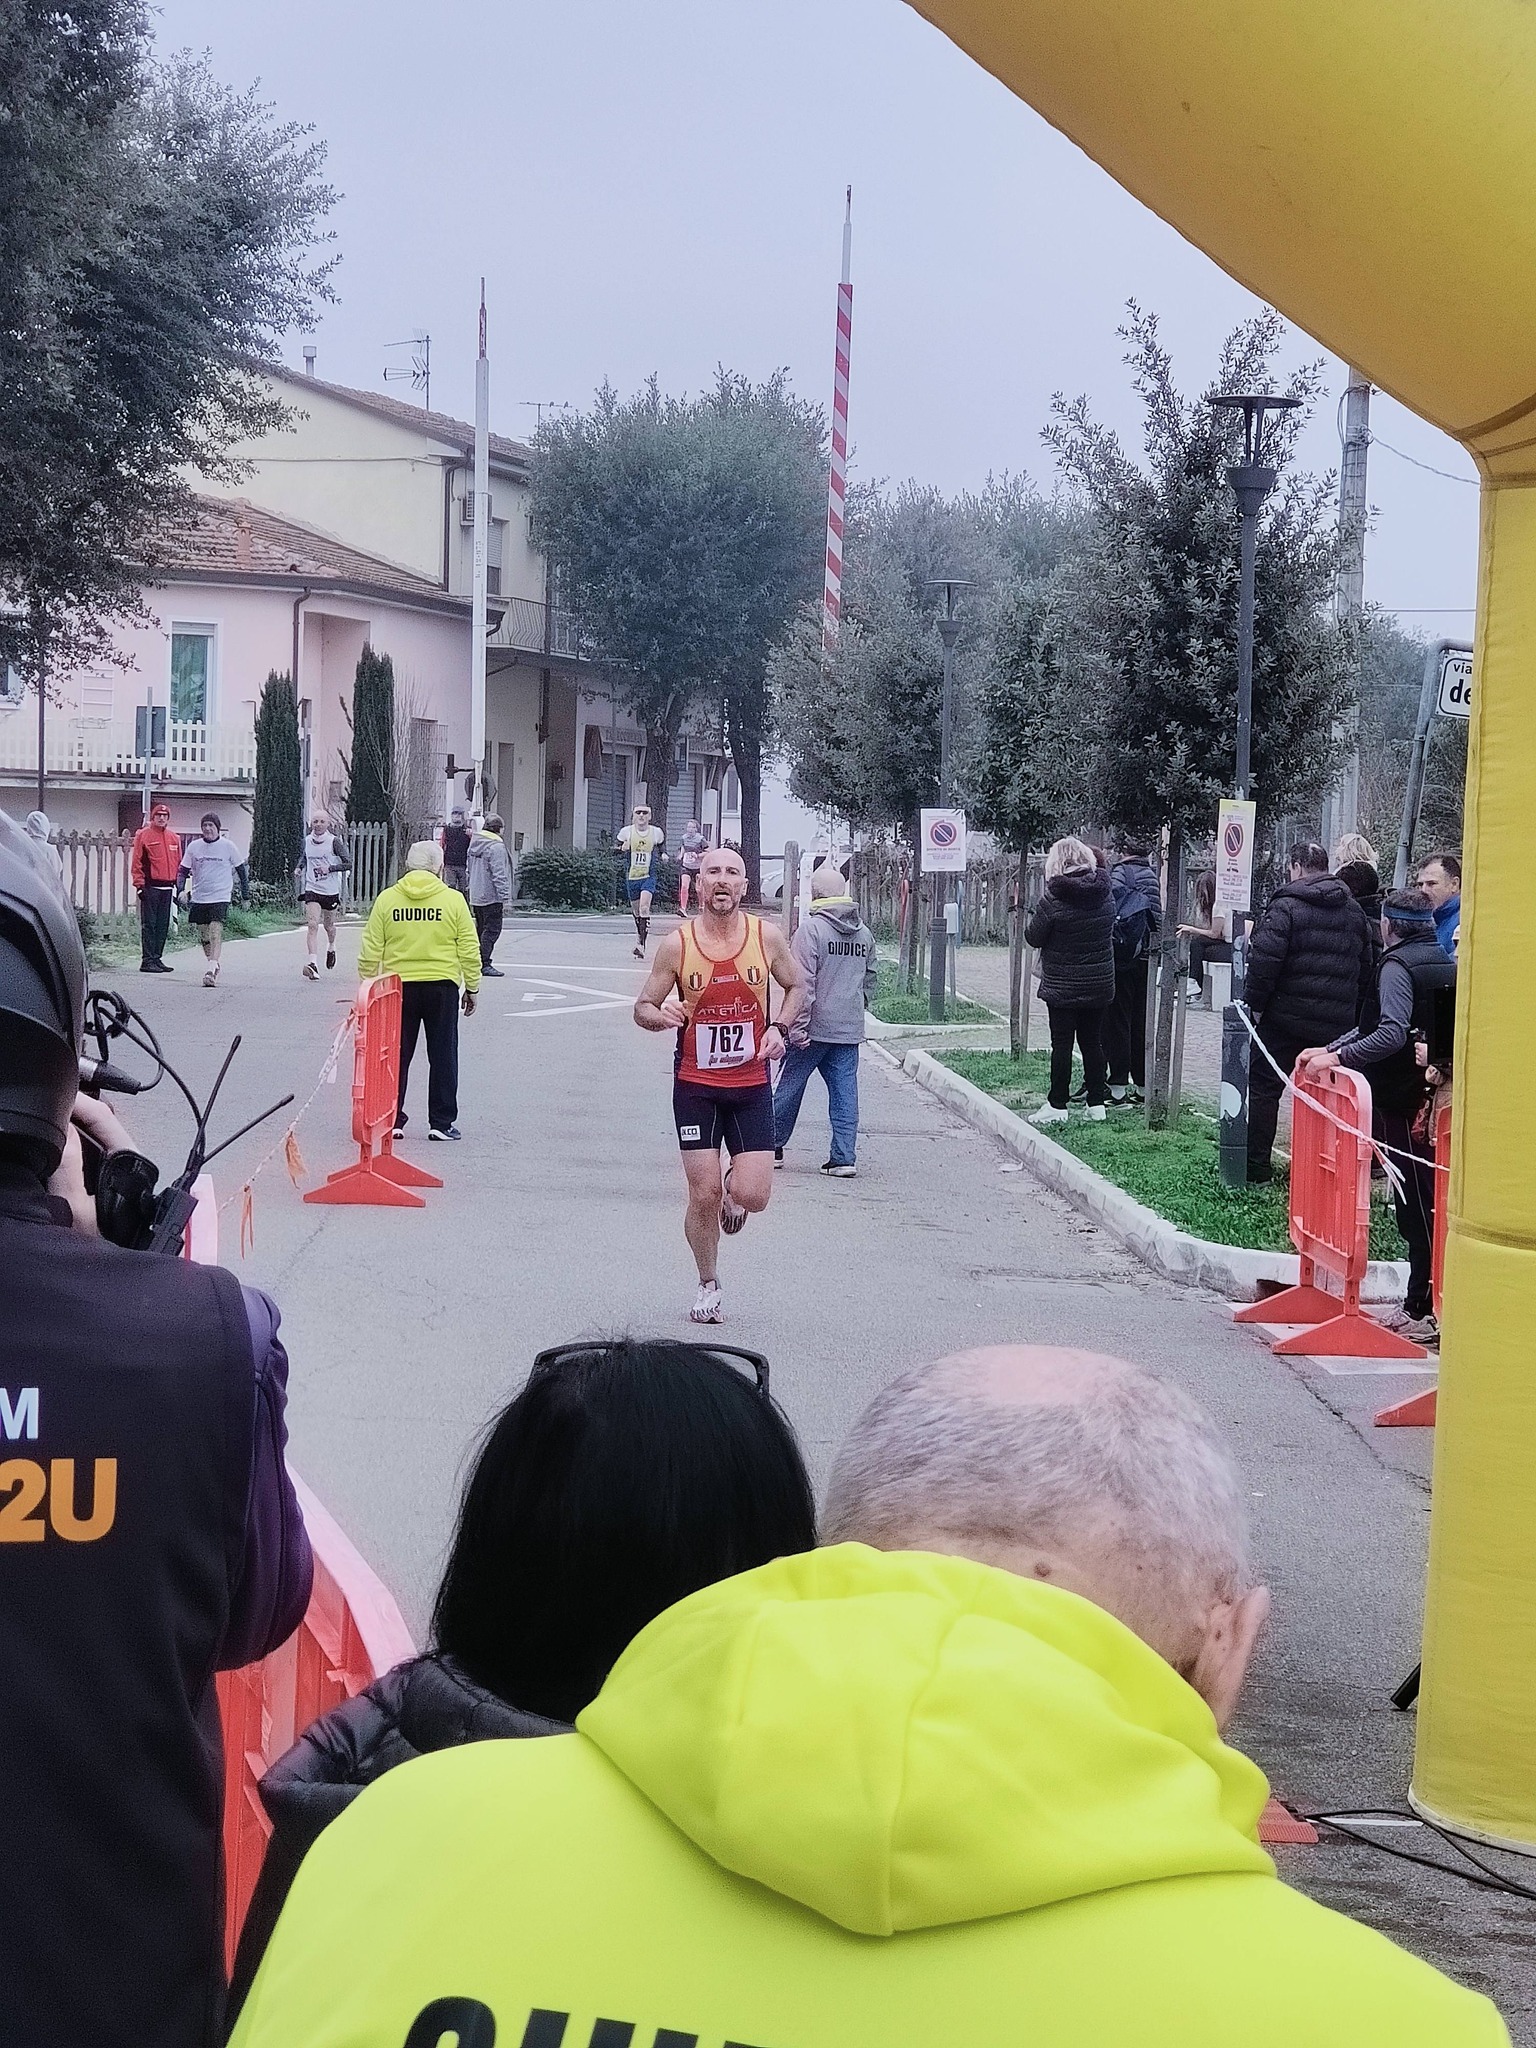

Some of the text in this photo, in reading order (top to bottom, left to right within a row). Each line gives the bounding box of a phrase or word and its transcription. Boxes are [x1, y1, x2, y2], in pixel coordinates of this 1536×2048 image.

[1453, 662, 1472, 675] via
[392, 907, 442, 922] GIUDICE
[827, 941, 866, 958] GIUDICE
[707, 1024, 745, 1054] 762
